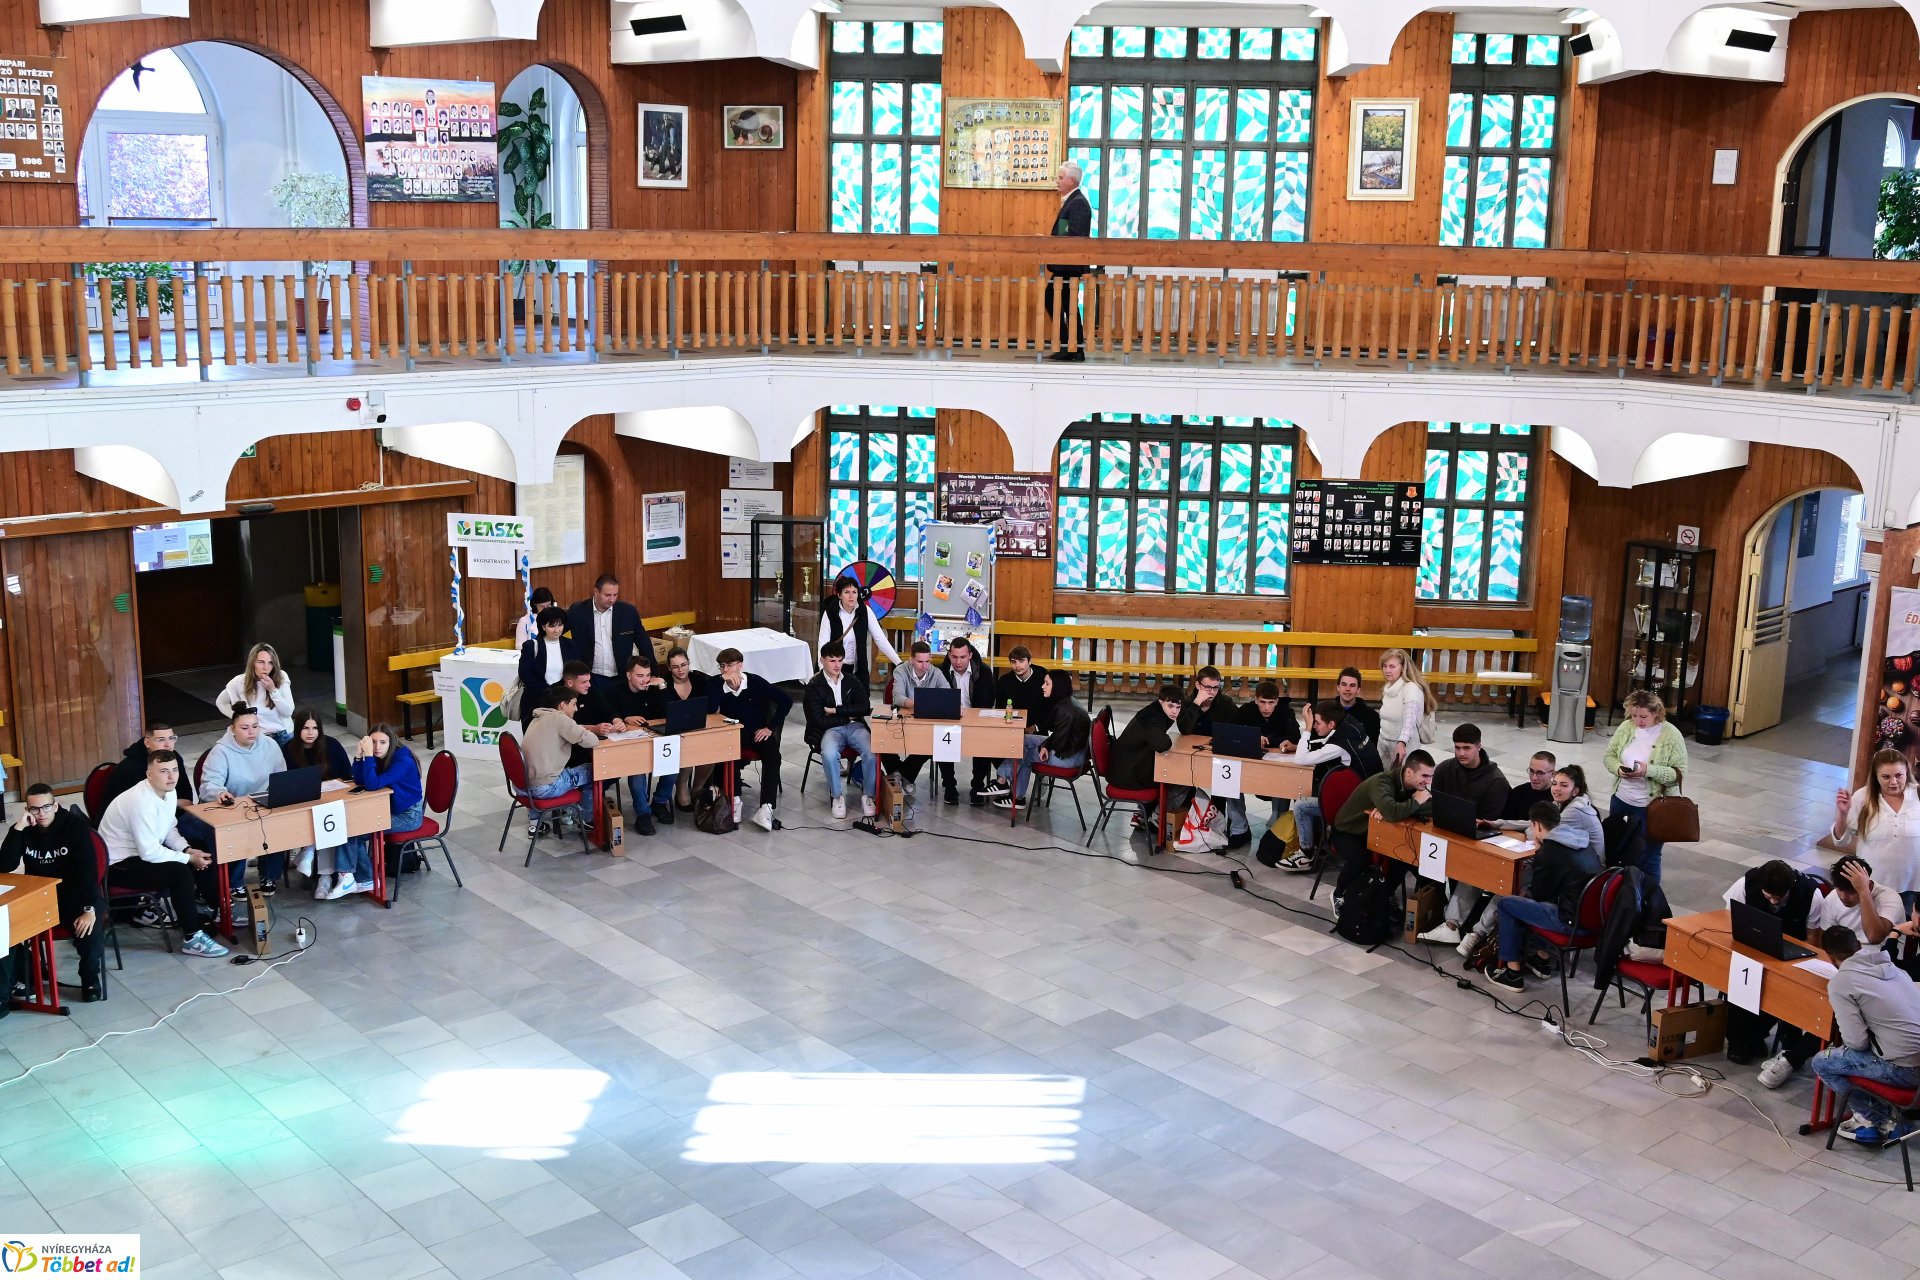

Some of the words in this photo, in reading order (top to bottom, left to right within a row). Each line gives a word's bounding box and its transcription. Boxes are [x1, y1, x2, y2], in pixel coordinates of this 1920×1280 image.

[1905, 611, 1920, 625] ÉD
[462, 729, 500, 745] EASZ
[942, 732, 952, 744] 4
[662, 744, 672, 758] 5
[1222, 765, 1231, 779] 3
[323, 813, 336, 832] 6
[25, 846, 69, 859] MILANO
[1428, 842, 1438, 860] 2
[1742, 968, 1748, 985] 1
